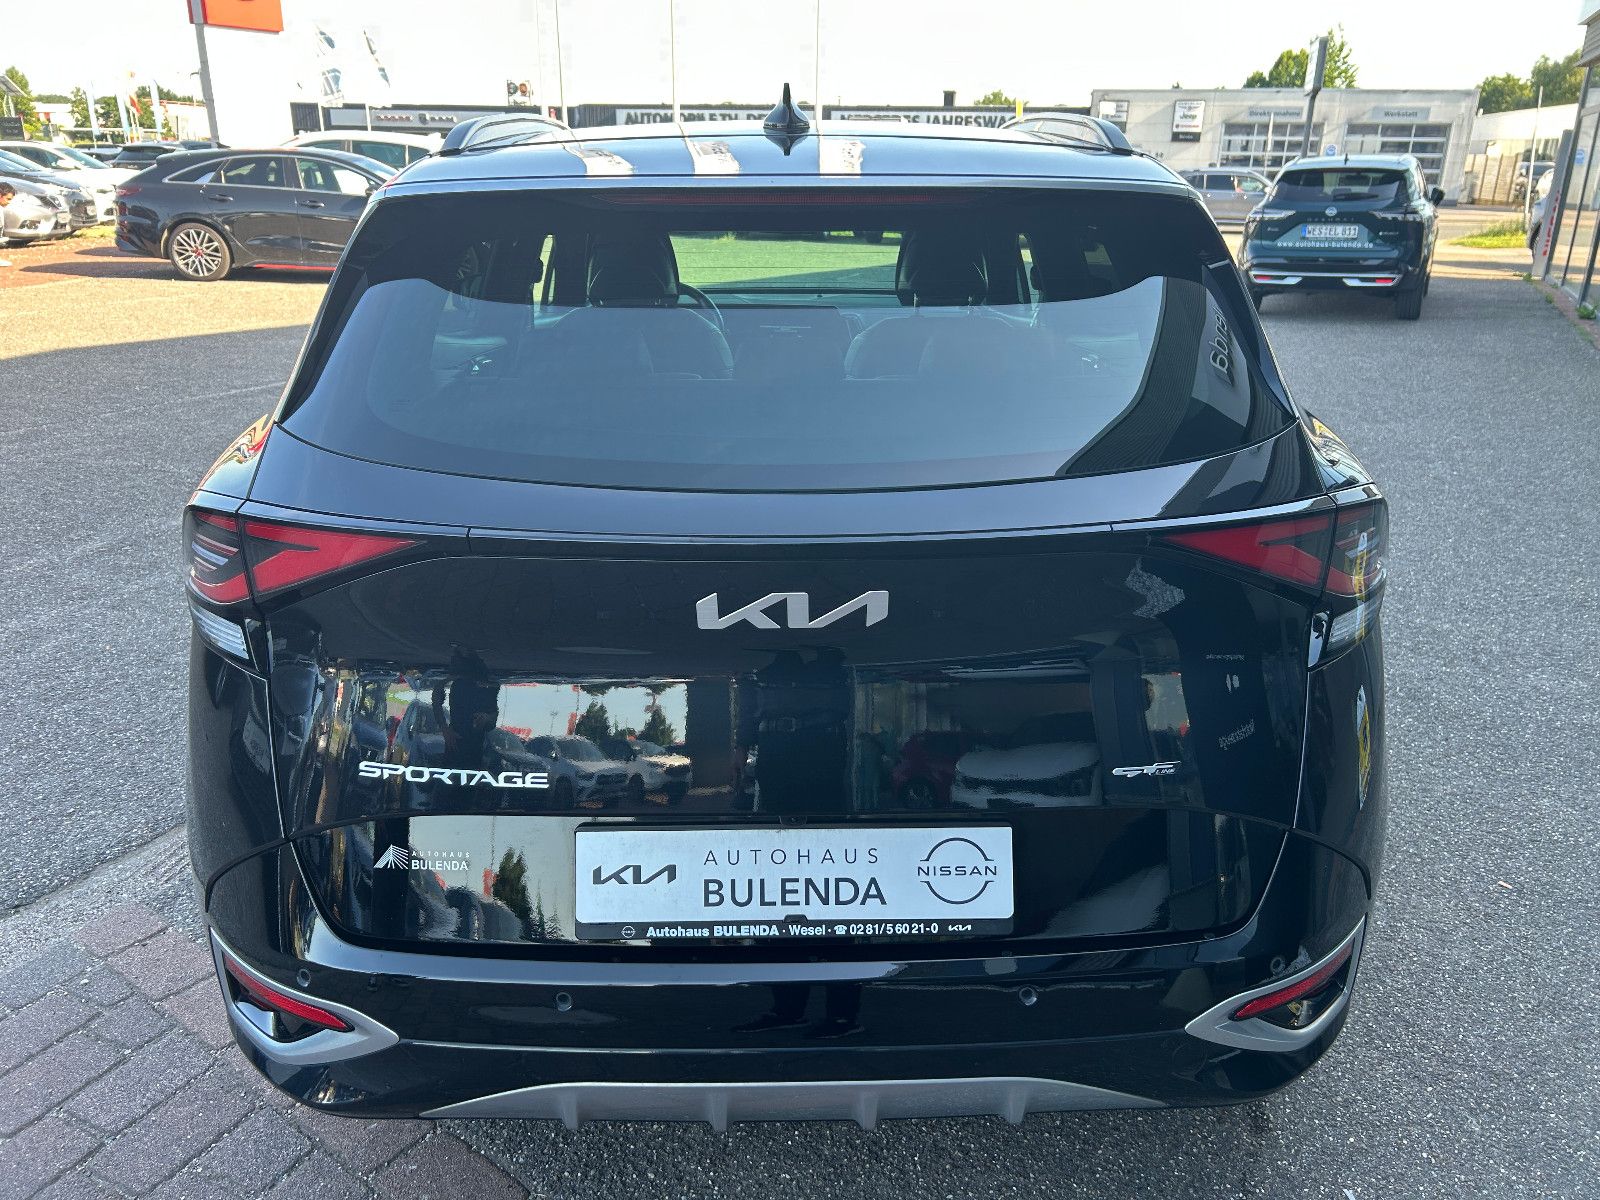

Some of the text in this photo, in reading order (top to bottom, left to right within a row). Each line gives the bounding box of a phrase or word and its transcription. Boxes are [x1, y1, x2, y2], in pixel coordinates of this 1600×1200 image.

[358, 760, 550, 789] SPORTAGE
[411, 850, 471, 859] AUTOHAUS
[703, 847, 880, 866] AUTOHAUS
[411, 860, 469, 871] BULENDA
[916, 864, 998, 877] NISSAN
[703, 876, 888, 908] BULENDA
[645, 926, 710, 938] Autohaus
[713, 925, 780, 937] BULENDA
[788, 924, 826, 936] Wesel
